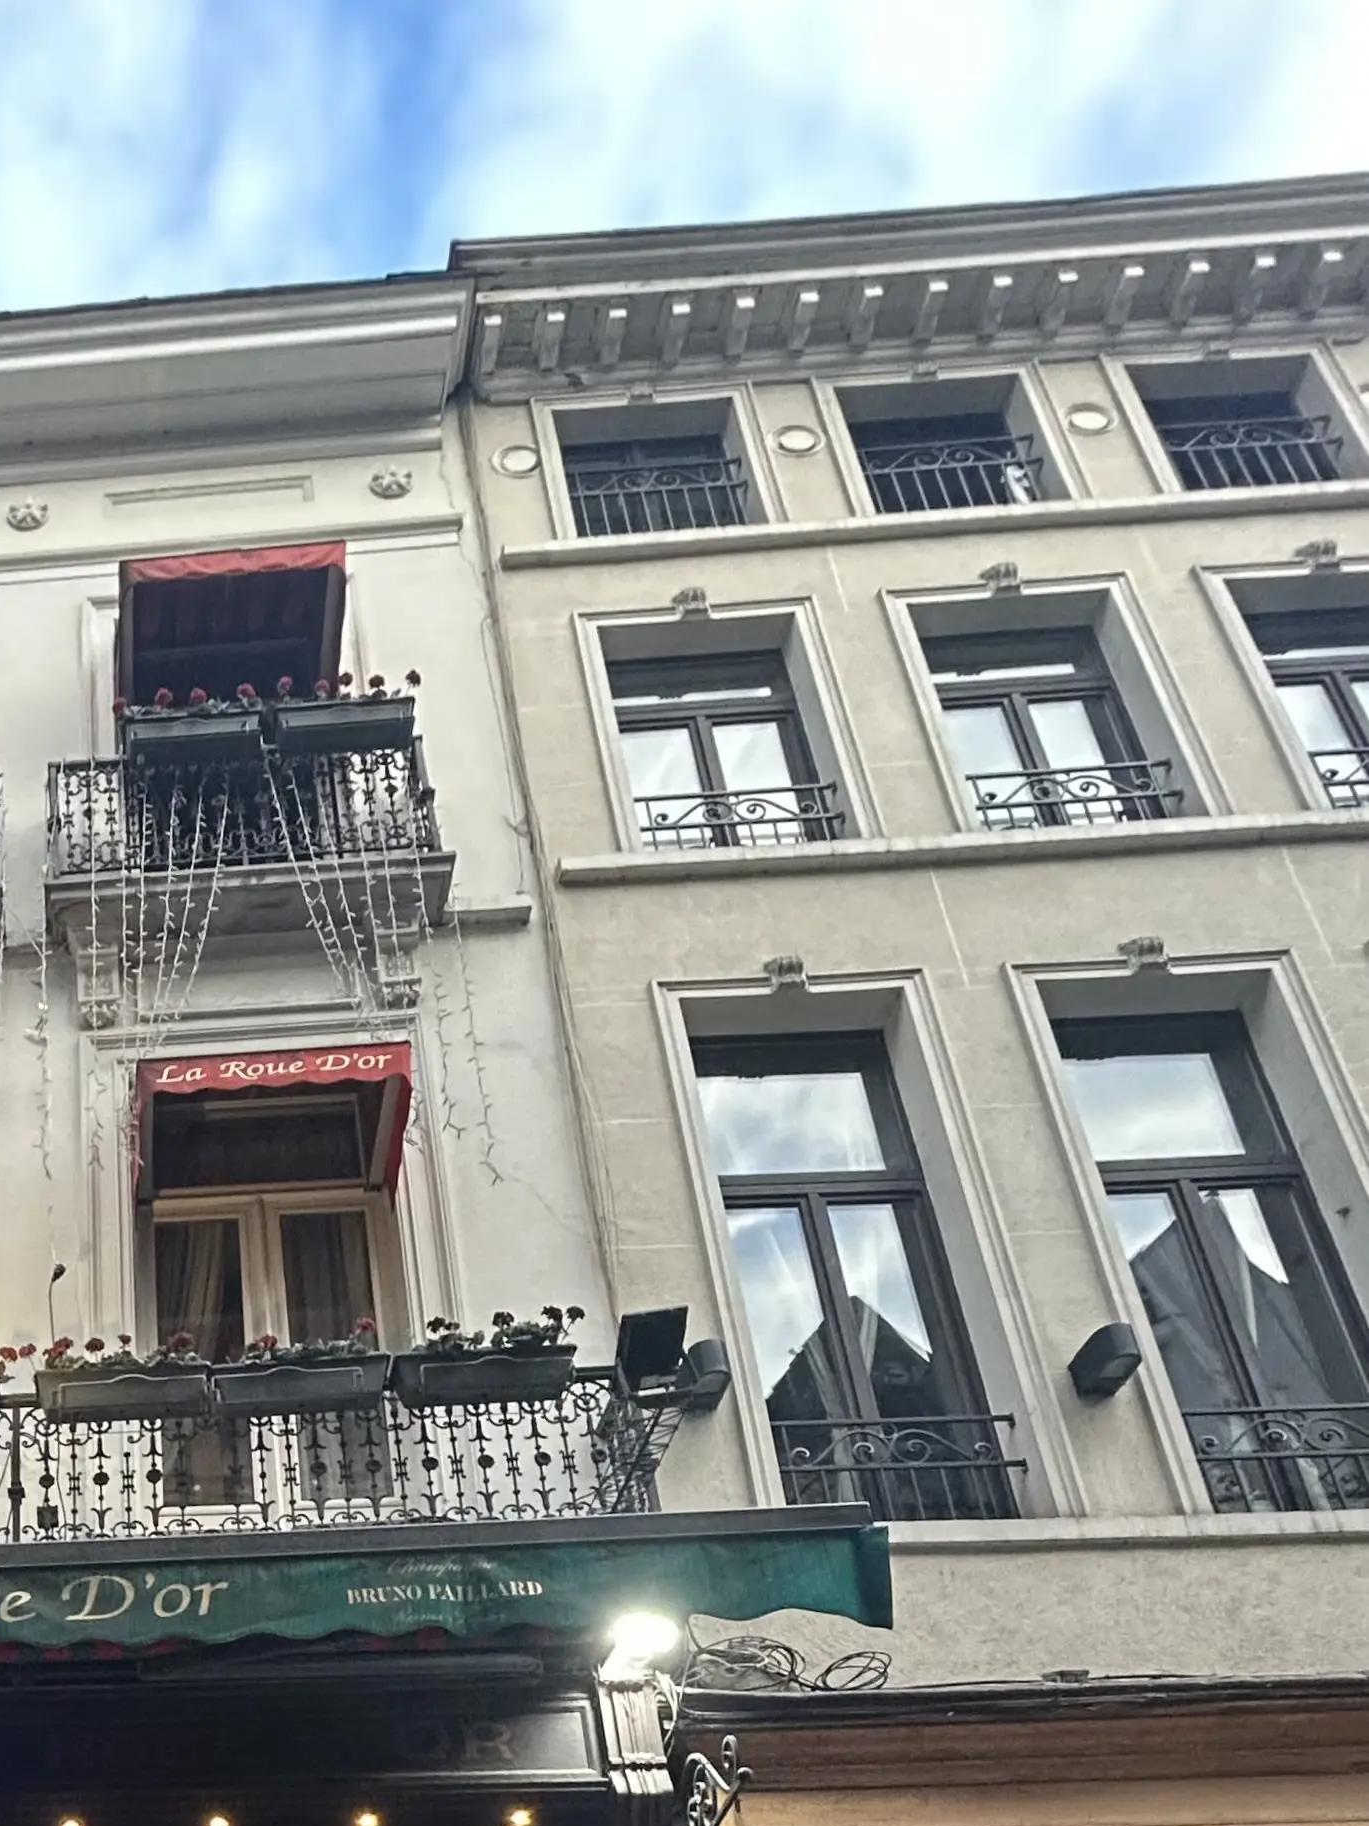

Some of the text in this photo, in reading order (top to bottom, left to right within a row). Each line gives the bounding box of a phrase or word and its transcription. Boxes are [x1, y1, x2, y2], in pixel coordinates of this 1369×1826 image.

[156, 1053, 392, 1084] La Roue D'or
[61, 1573, 228, 1621] D'or
[346, 1580, 543, 1605] BRUNO PAILLARD
